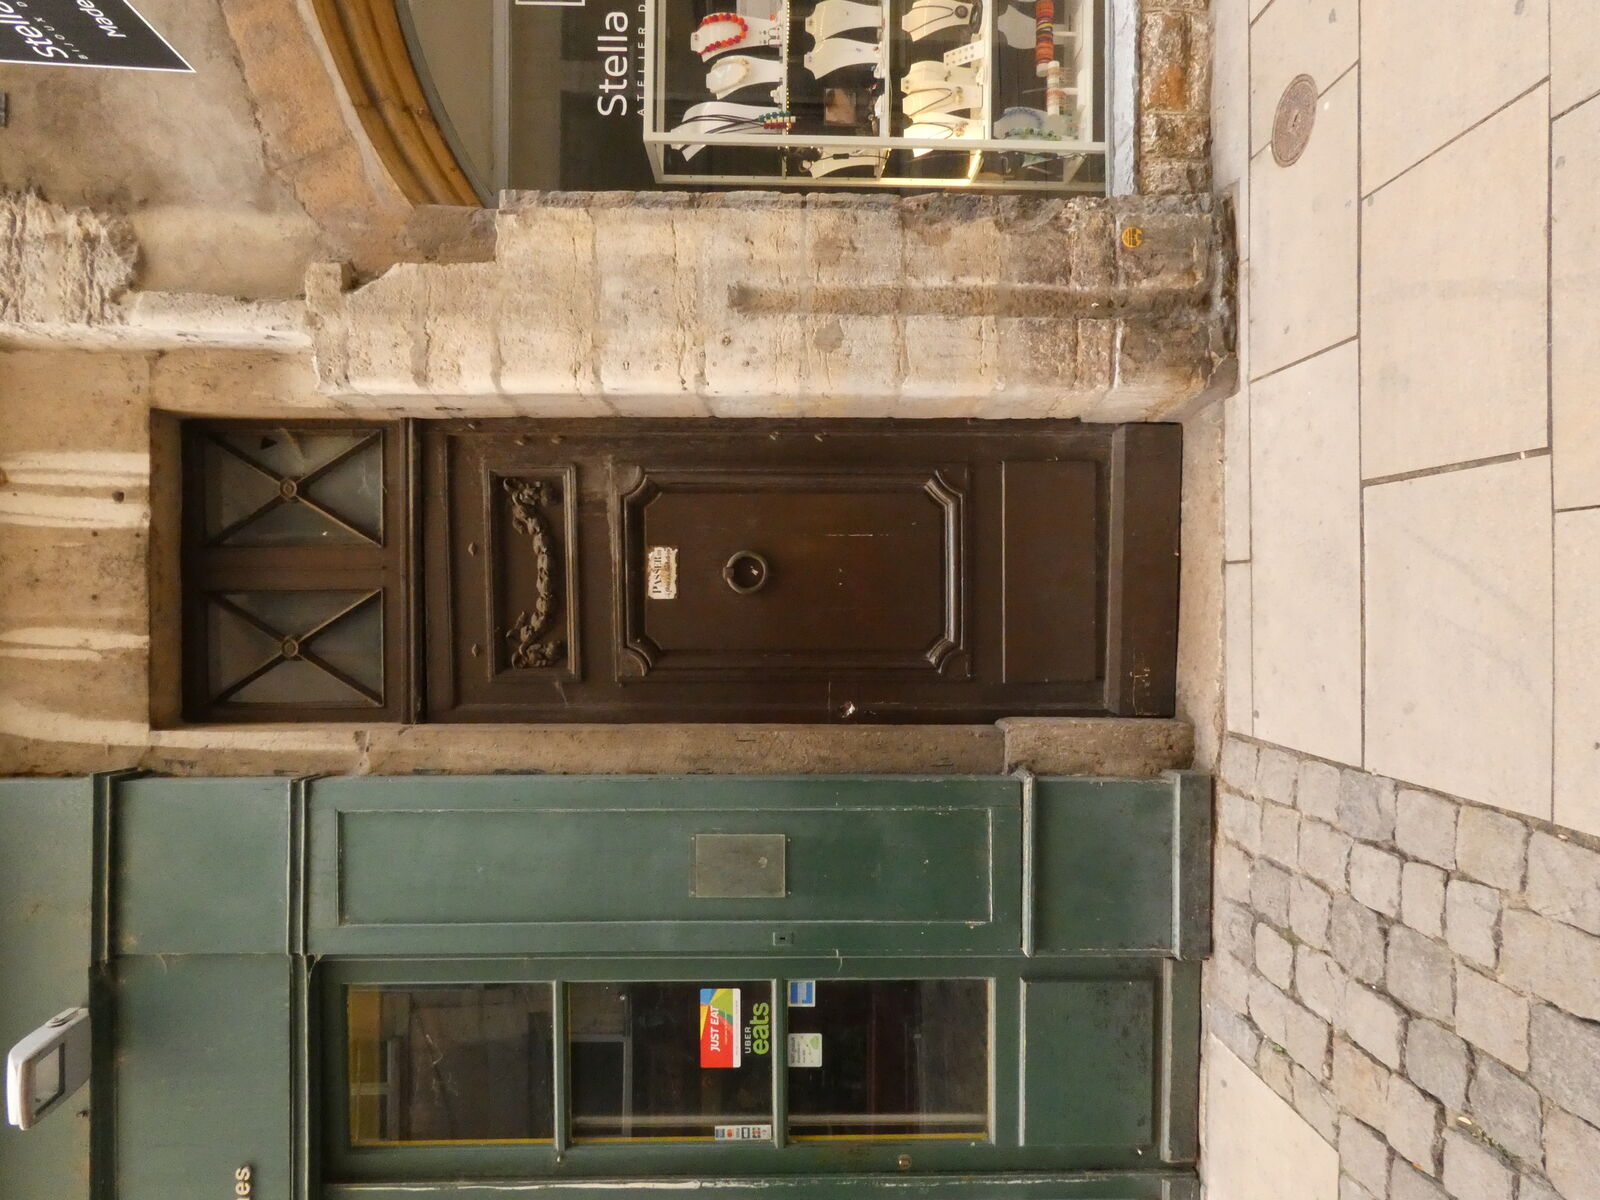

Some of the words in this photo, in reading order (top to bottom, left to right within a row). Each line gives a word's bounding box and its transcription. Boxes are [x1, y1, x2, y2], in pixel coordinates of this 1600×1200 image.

[33, 17, 88, 60] BIJOUX
[76, 0, 127, 38] Made
[597, 11, 628, 116] Stella
[637, 27, 646, 117] ATELIER
[710, 1006, 720, 1026] EAT
[750, 1002, 769, 1054] eats
[710, 1027, 721, 1052] JUST
[235, 1166, 251, 1200] es
